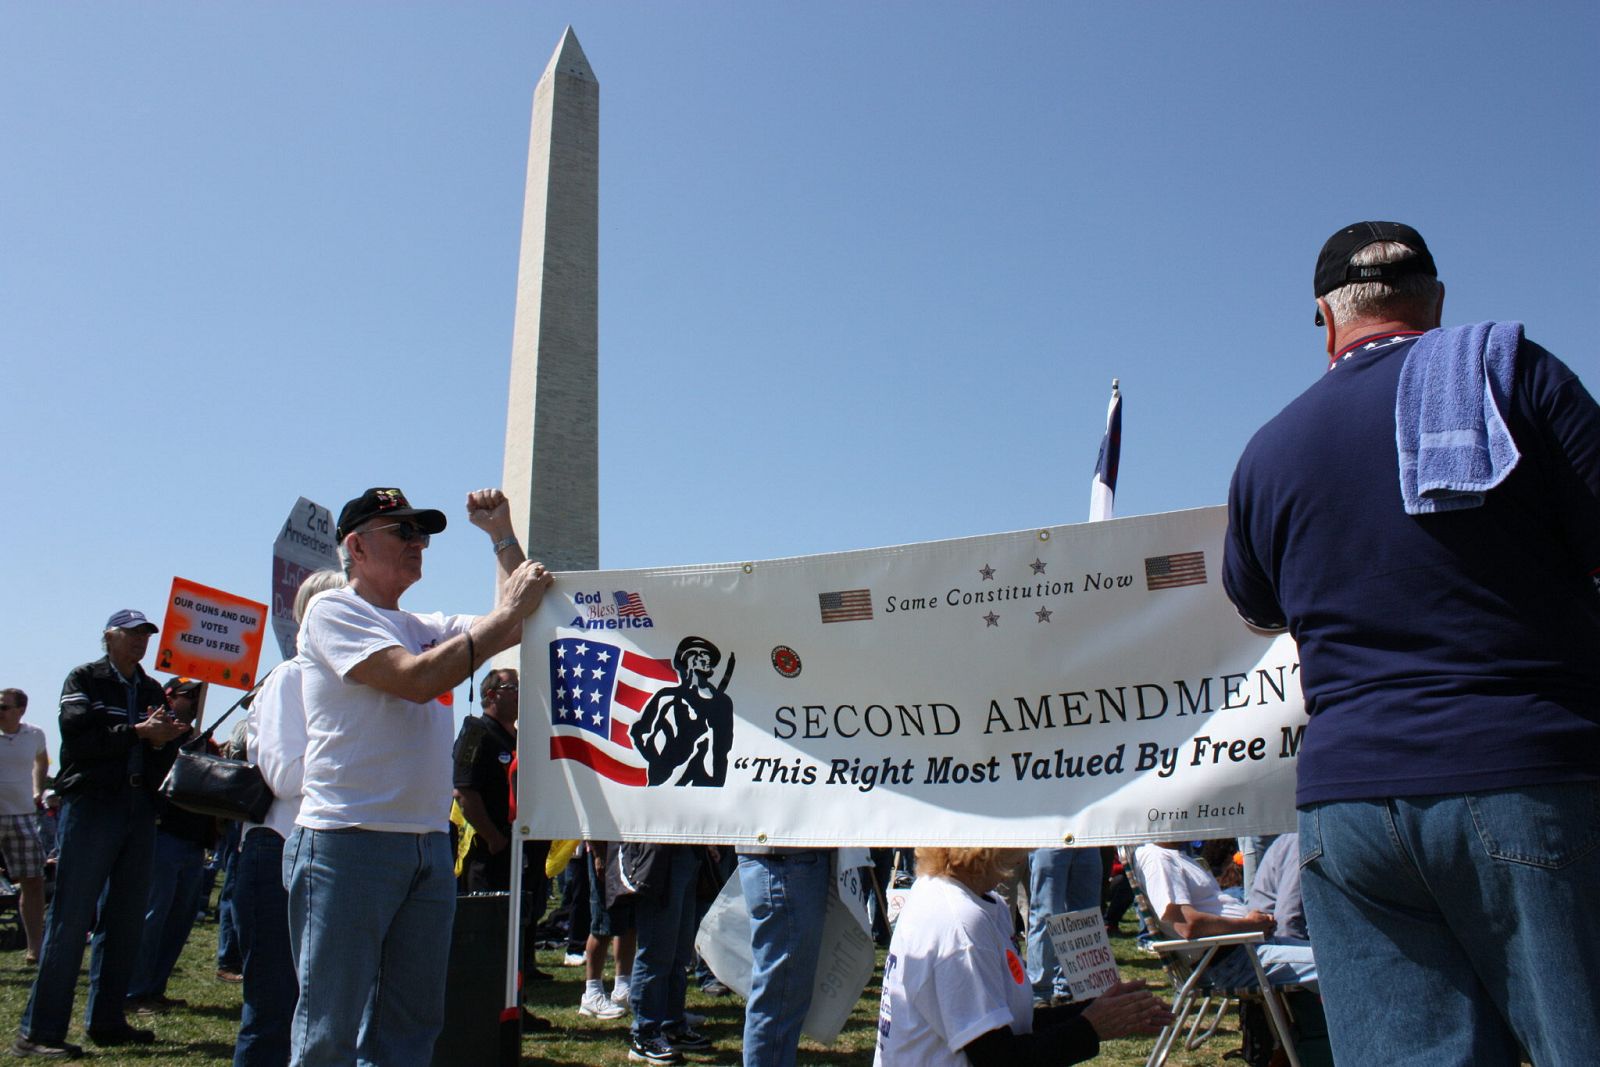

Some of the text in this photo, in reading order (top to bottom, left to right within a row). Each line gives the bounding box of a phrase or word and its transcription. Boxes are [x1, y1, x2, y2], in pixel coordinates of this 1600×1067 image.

[306, 502, 329, 535] 2nd
[574, 590, 602, 605] God
[885, 572, 1133, 613] Same Constitution Now
[174, 596, 257, 627] OUR GUNS AND OUR
[569, 615, 654, 630] America
[587, 604, 616, 619] Bless
[200, 620, 229, 634] VOTES
[180, 632, 241, 654] KEEP US FREE
[774, 703, 961, 740] SECOND
[825, 756, 914, 793] Right
[923, 755, 1001, 785] Most
[1011, 743, 1126, 781] Valued
[1135, 742, 1180, 778] By
[1190, 735, 1266, 767] Free
[1147, 802, 1245, 822] Orrin Hatch
[1076, 945, 1110, 971] CITIZENS
